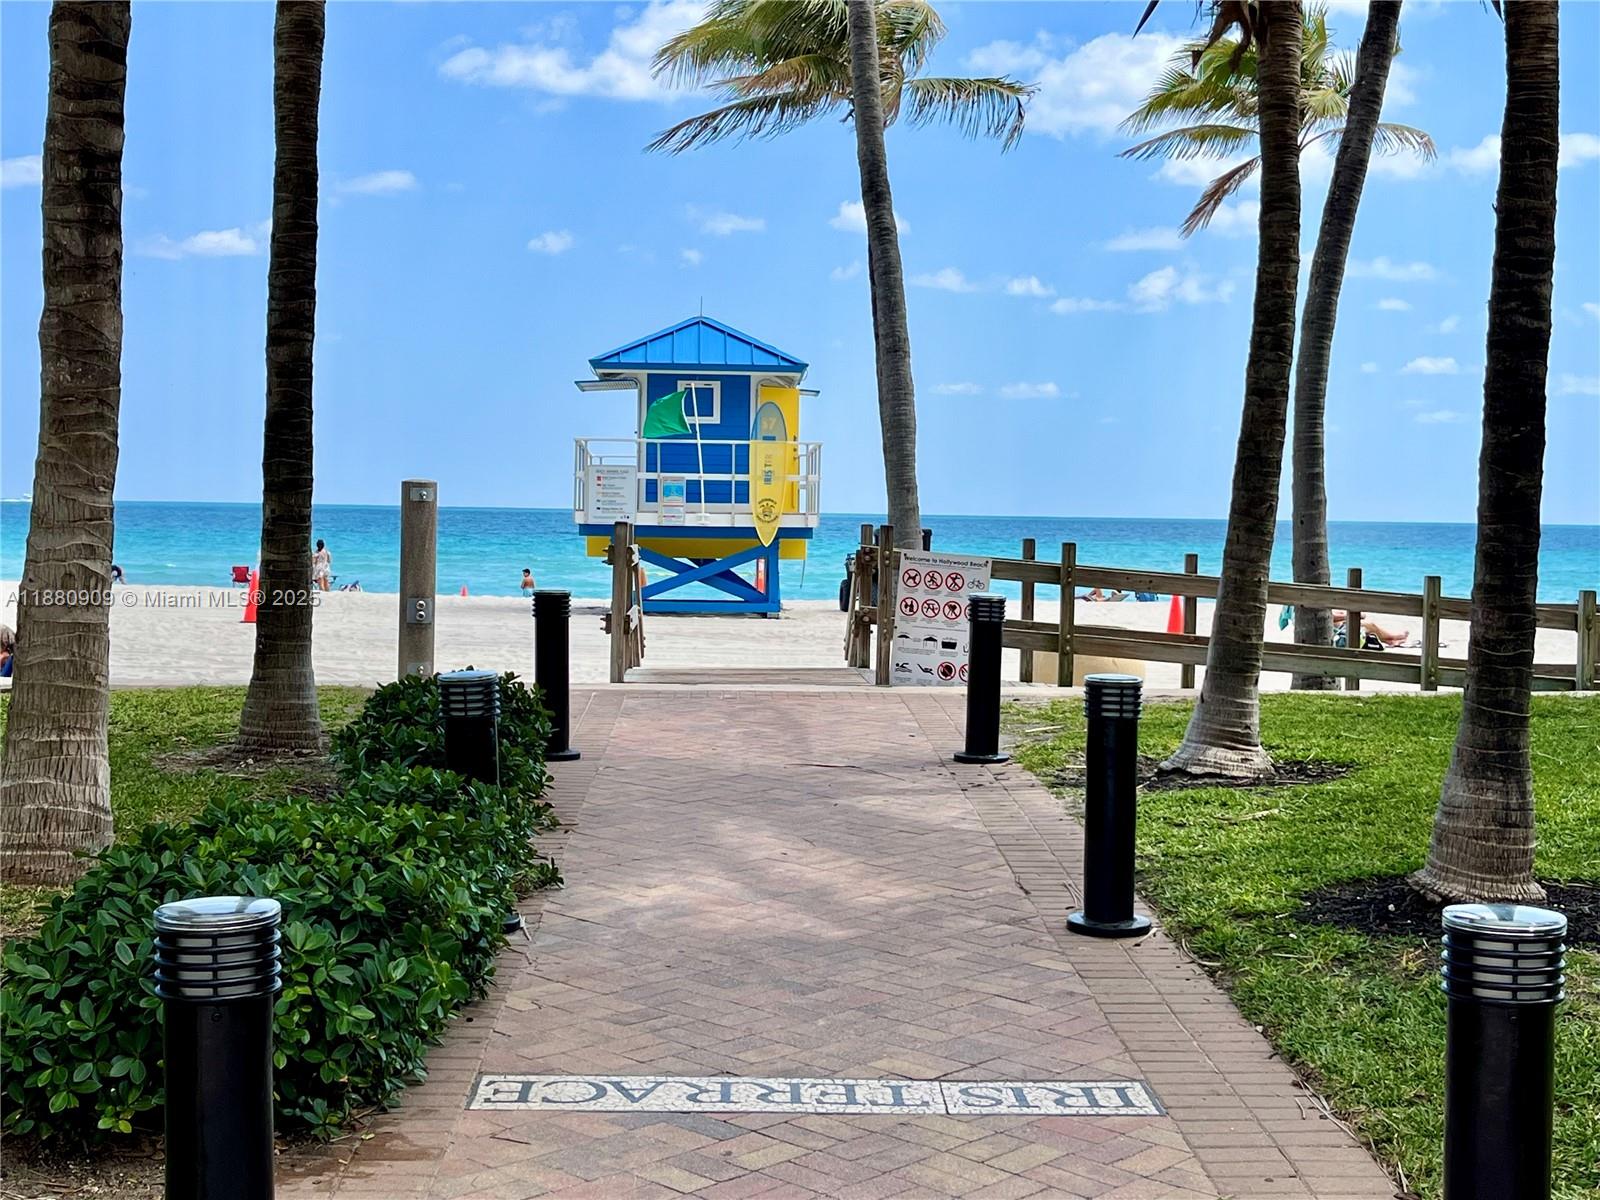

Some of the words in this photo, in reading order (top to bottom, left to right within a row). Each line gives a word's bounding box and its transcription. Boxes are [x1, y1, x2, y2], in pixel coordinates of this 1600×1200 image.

[939, 559, 968, 567] Hollywood
[483, 1079, 931, 1107] TERRACE
[958, 1085, 1145, 1108] IRIS
